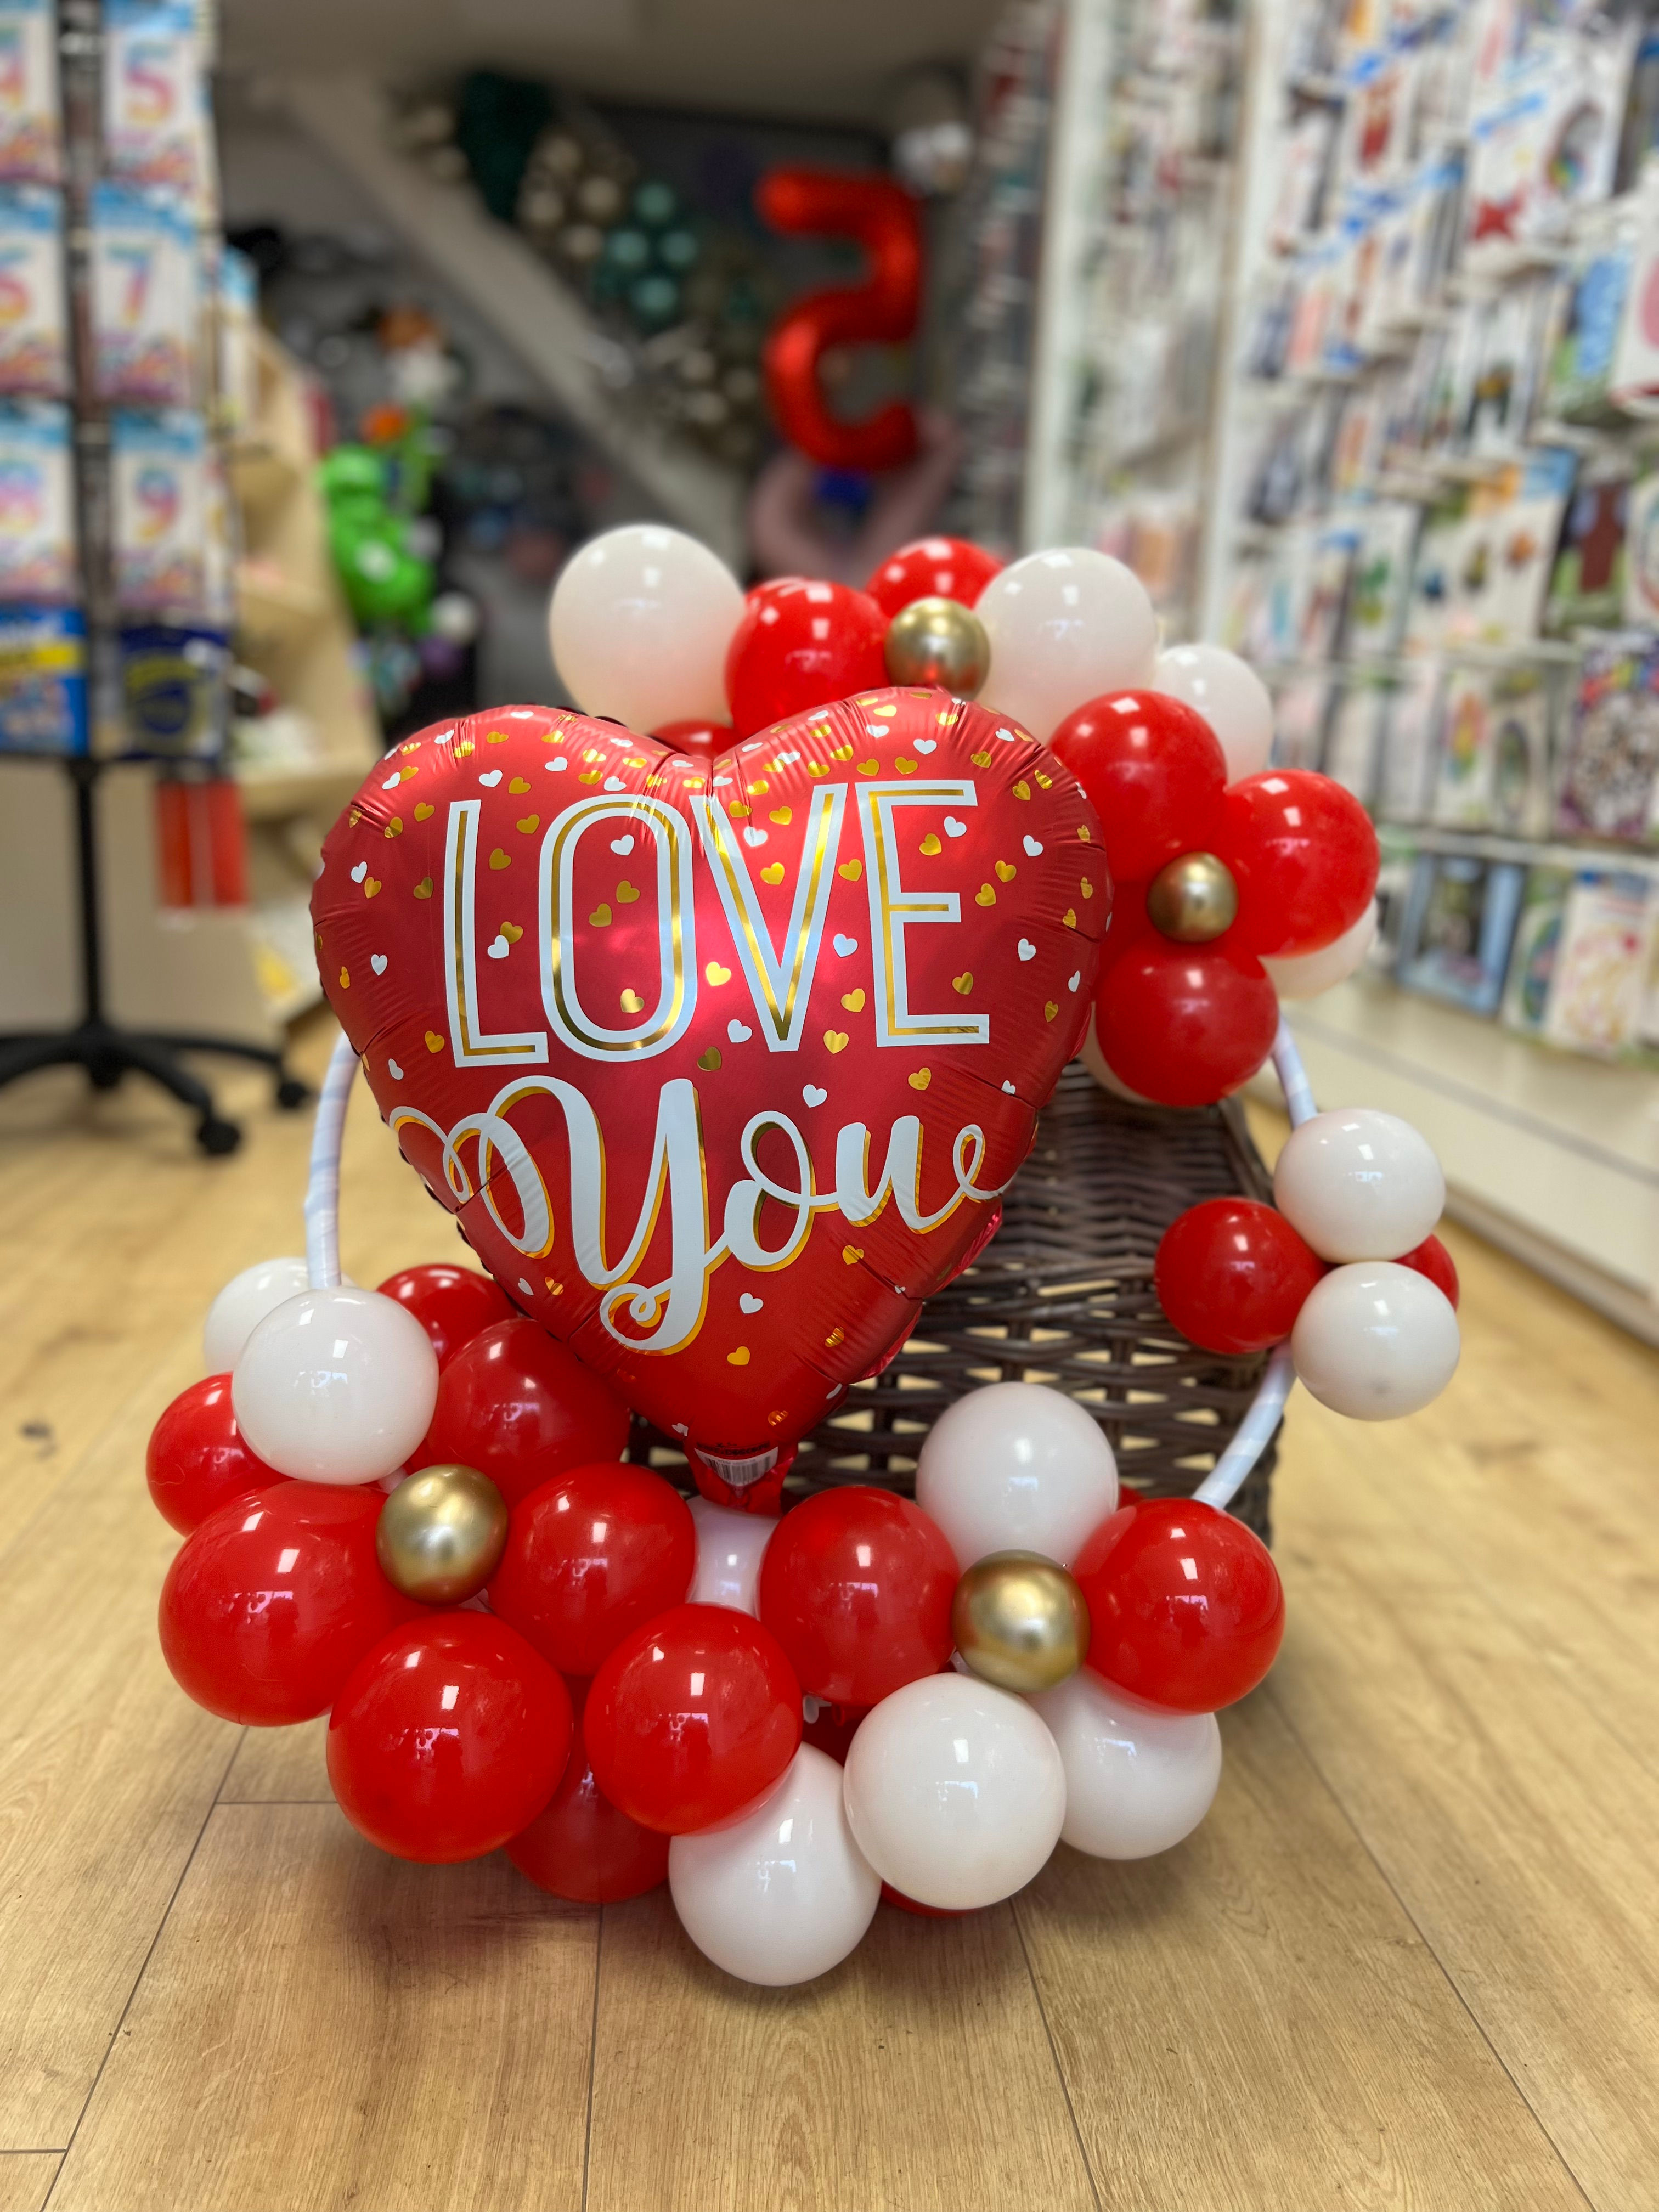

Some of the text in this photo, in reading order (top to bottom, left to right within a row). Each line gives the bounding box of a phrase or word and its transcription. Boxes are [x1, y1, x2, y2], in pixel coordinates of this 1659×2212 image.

[125, 42, 175, 127] 5
[107, 242, 153, 324] 7
[136, 464, 178, 544] 9
[444, 781, 990, 1067] LOVE
[391, 1076, 1015, 1355] You
